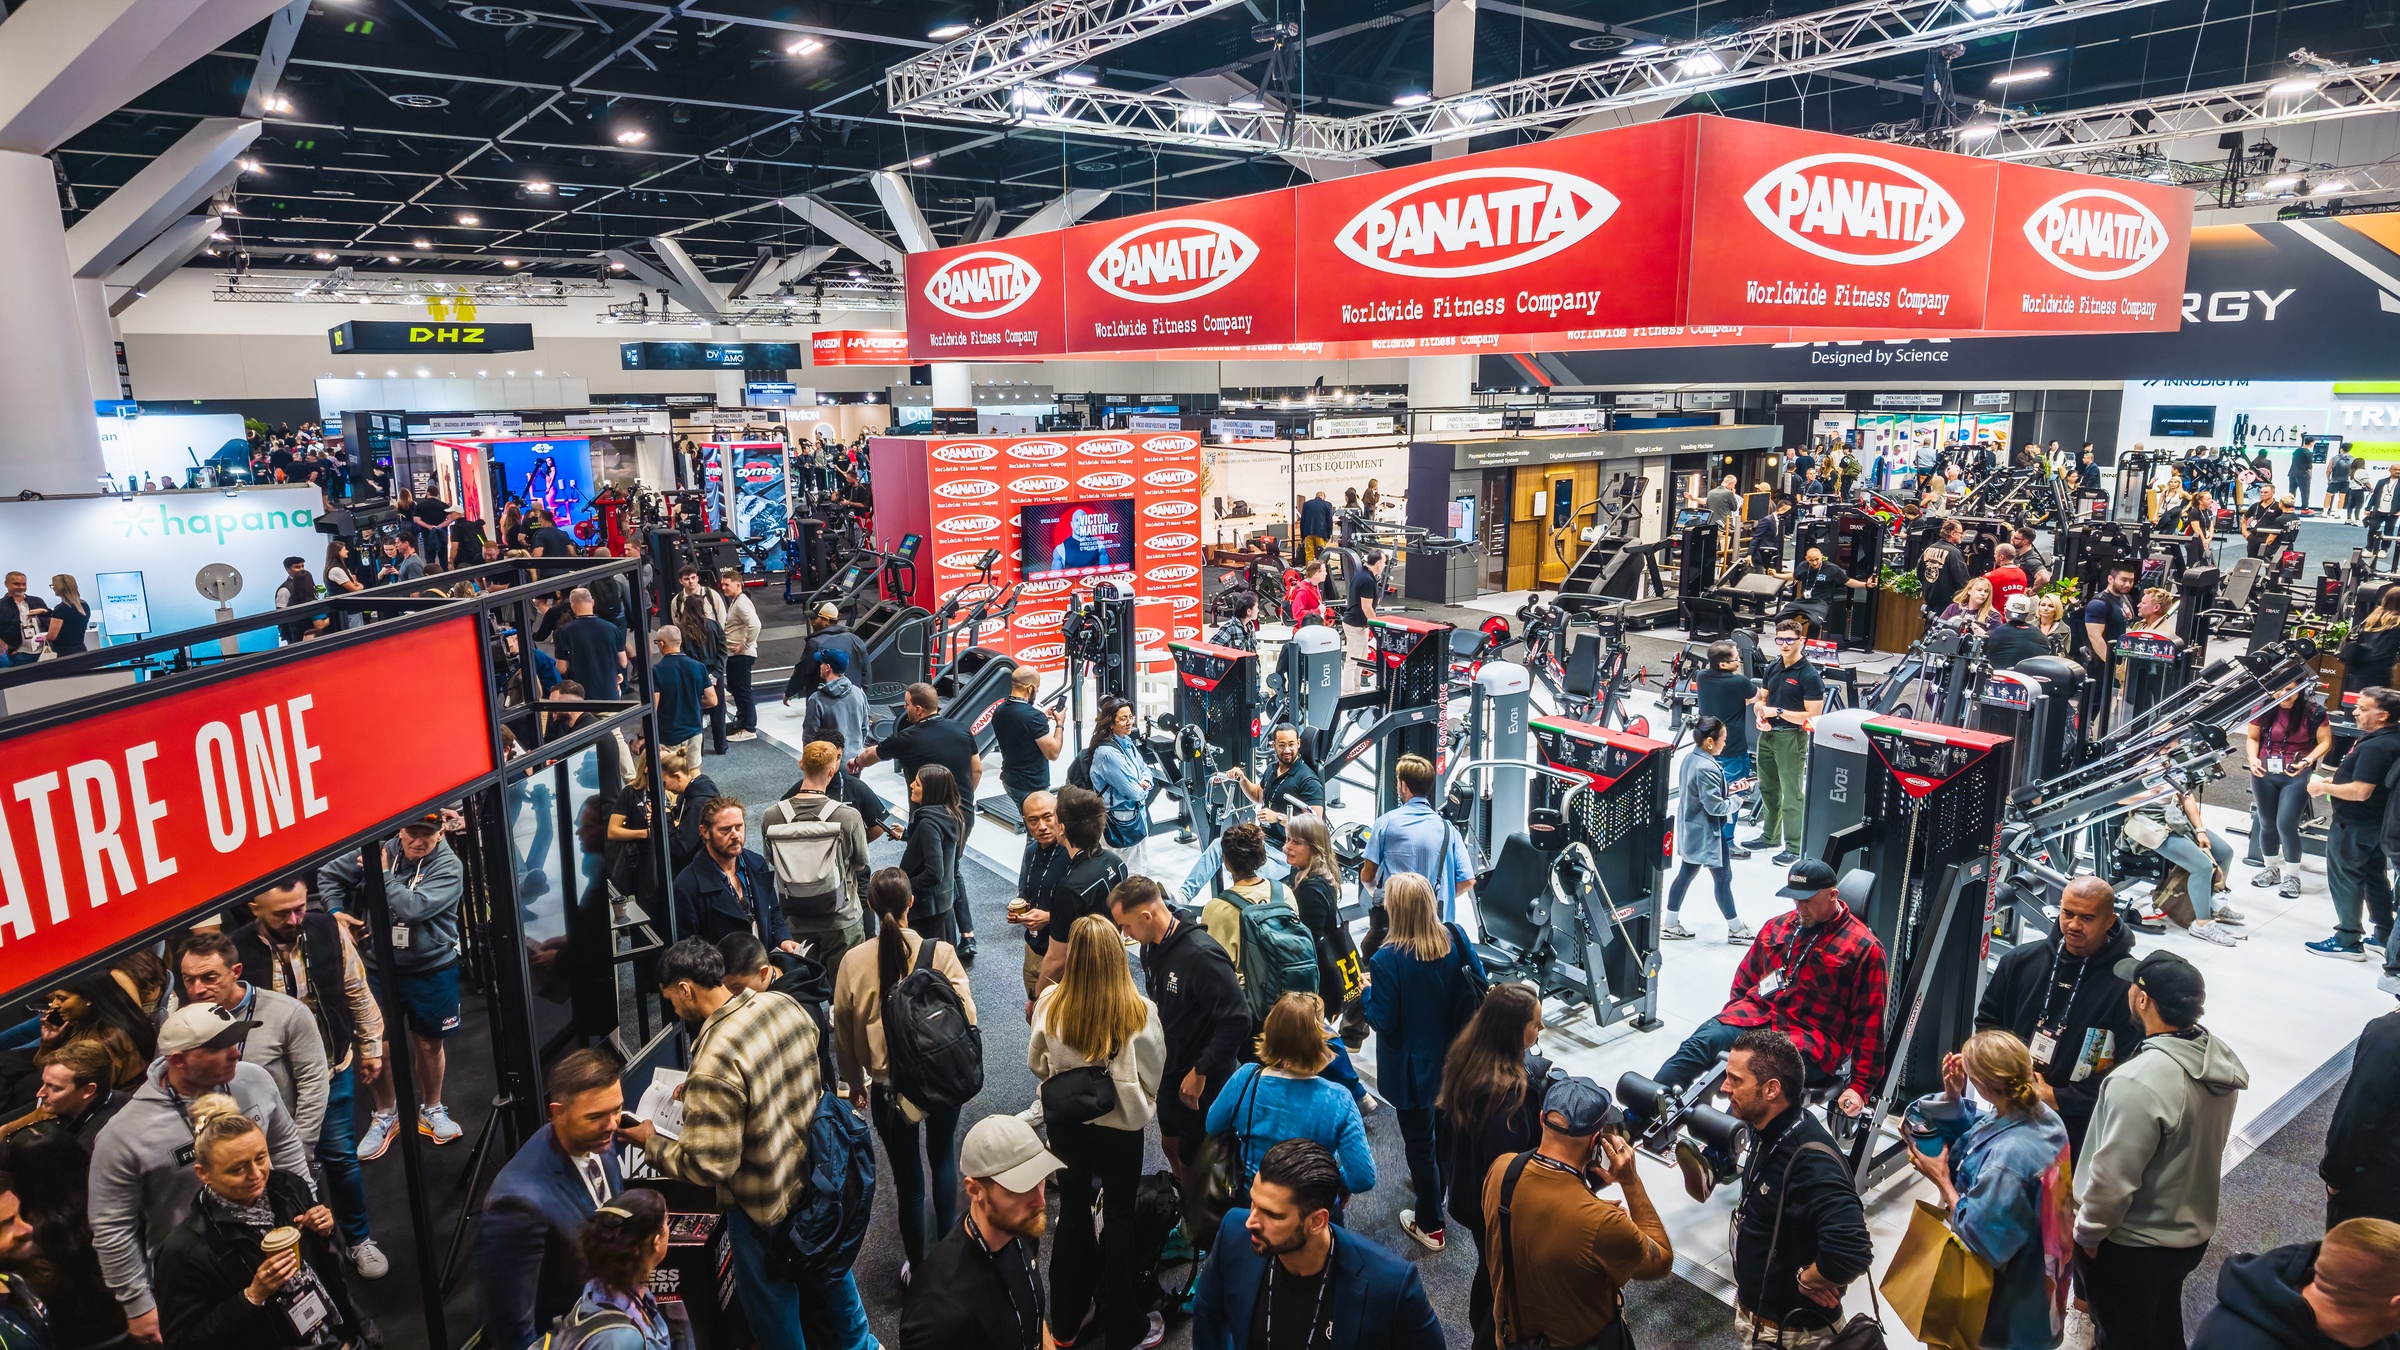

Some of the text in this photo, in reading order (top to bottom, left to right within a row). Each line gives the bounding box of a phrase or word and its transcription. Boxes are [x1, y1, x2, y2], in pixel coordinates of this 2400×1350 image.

[1779, 173, 1946, 242] PANATTA
[1367, 184, 1578, 259] PANATTA
[2046, 206, 2155, 261] PANATTA
[1107, 234, 1238, 287] PANATTA
[938, 264, 1030, 305] PANATTA
[1746, 281, 1950, 316] Worldwide Fitness Company
[1342, 290, 1600, 324] Worldwide Fitness Company
[2022, 294, 2157, 320] Worldwide Fitness Company
[2182, 289, 2296, 323] RGY
[1095, 314, 1252, 338] Worldwide Fitness Company
[409, 328, 485, 343] DHZ
[930, 330, 1038, 347] Worldwide Fitness Company
[1372, 337, 1415, 350] Worldwide
[1460, 334, 1499, 349] Company
[1812, 348, 1949, 366] Designed by Science
[1015, 445, 1060, 457] PANATTA
[1084, 442, 1128, 454] PANATTA
[1149, 439, 1192, 450] PANATTA
[941, 448, 989, 459] PANATTA
[1303, 452, 1357, 461] PROFESSIONAL
[1550, 452, 1565, 460] Digital
[1566, 450, 1592, 458] Assessment
[1325, 459, 1384, 472] EQUIPMENT
[736, 468, 782, 478] gym80
[1150, 472, 1192, 483] PANATTA
[1016, 480, 1062, 491] PANATTA
[1085, 476, 1130, 487] PANATTA
[943, 483, 992, 495] PANATTA
[1152, 504, 1193, 516] PANATTA
[160, 504, 314, 545] hapana
[945, 518, 993, 530] PANATTA
[1080, 514, 1108, 525] VICTOR
[1080, 523, 1118, 536] MARTINEZ
[1152, 536, 1194, 548] PANATTA
[1152, 567, 1194, 580] PANATTA
[195, 693, 329, 853] ONE
[1336, 950, 1361, 990] H
